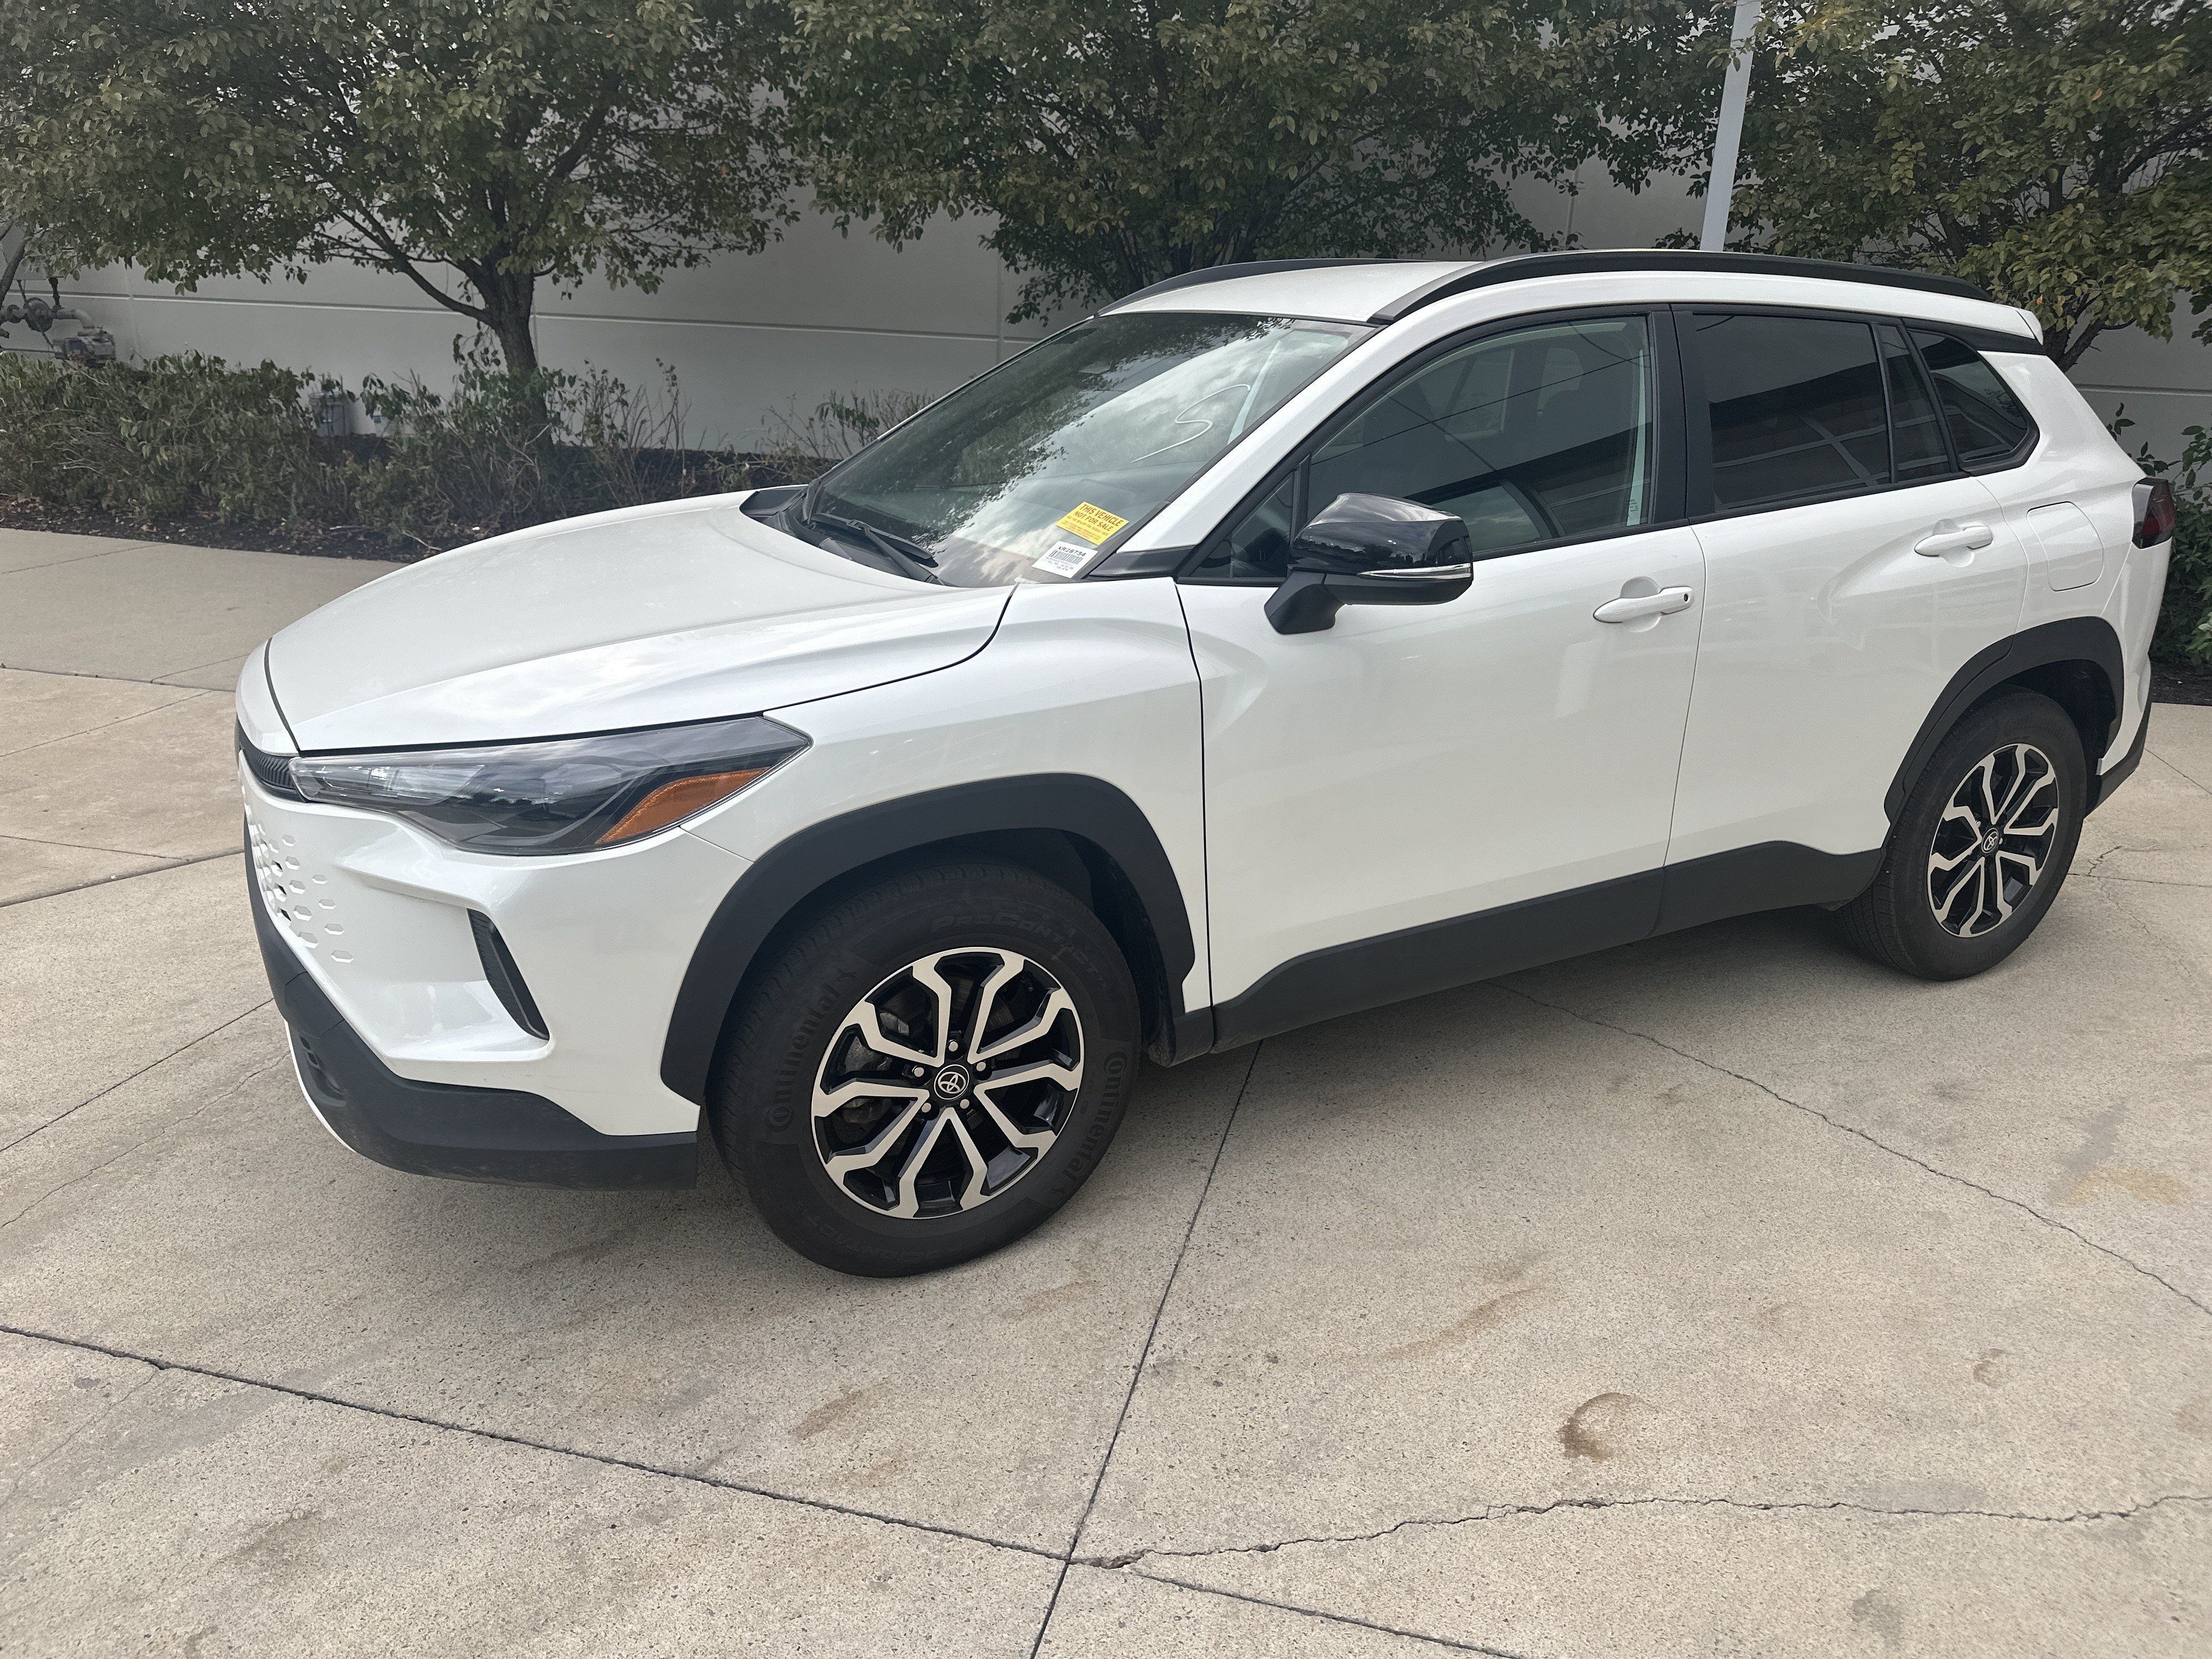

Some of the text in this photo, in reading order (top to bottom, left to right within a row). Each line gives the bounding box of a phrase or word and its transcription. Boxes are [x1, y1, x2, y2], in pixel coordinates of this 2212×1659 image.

[1074, 511, 1086, 519] NOT
[1085, 516, 1098, 524] FOR
[1097, 521, 1114, 532] SALE
[1079, 504, 1097, 515] THIS
[1094, 510, 1124, 527] VEHICLE
[764, 982, 842, 1132] Continental
[1063, 1051, 1127, 1183] Continental
